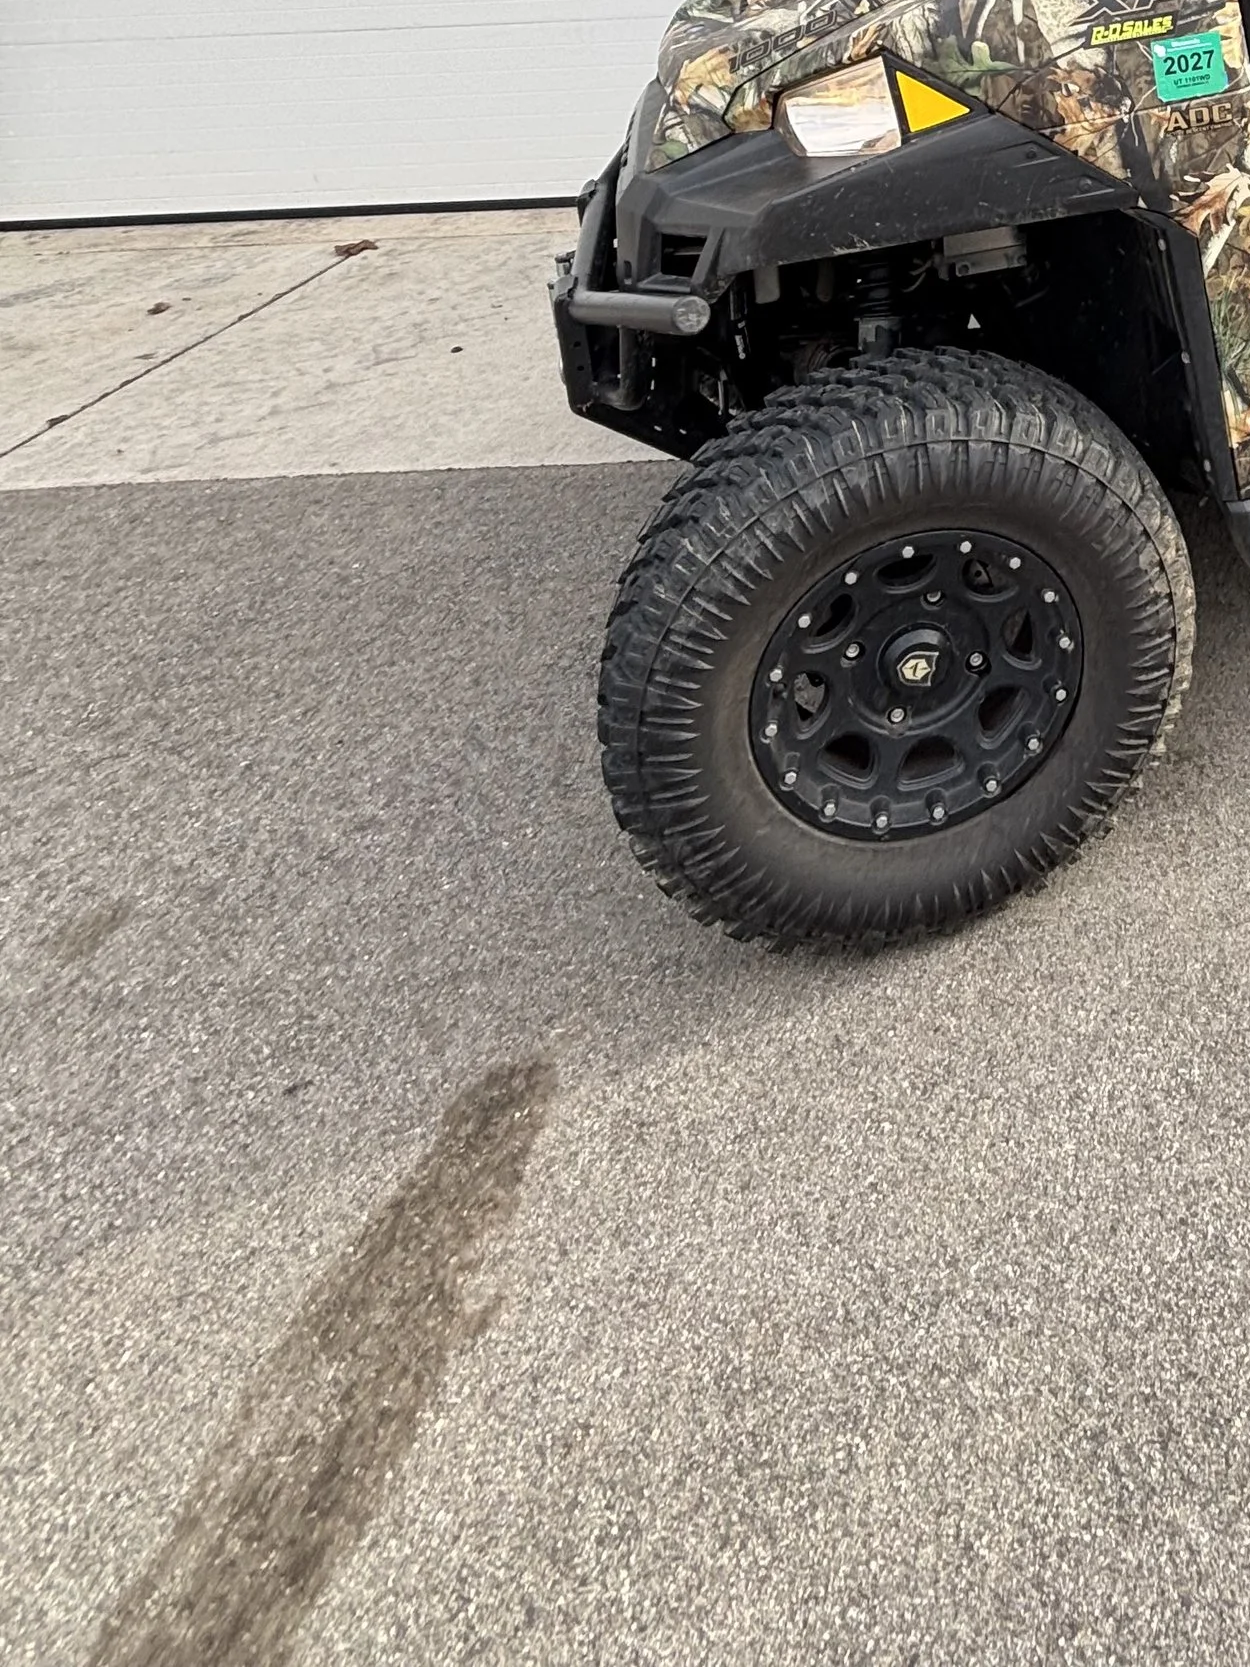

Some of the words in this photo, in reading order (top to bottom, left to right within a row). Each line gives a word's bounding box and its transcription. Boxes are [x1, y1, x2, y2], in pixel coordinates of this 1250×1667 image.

[729, 11, 838, 73] 1000
[1163, 50, 1215, 76] 2027
[1167, 103, 1232, 132] ADC
